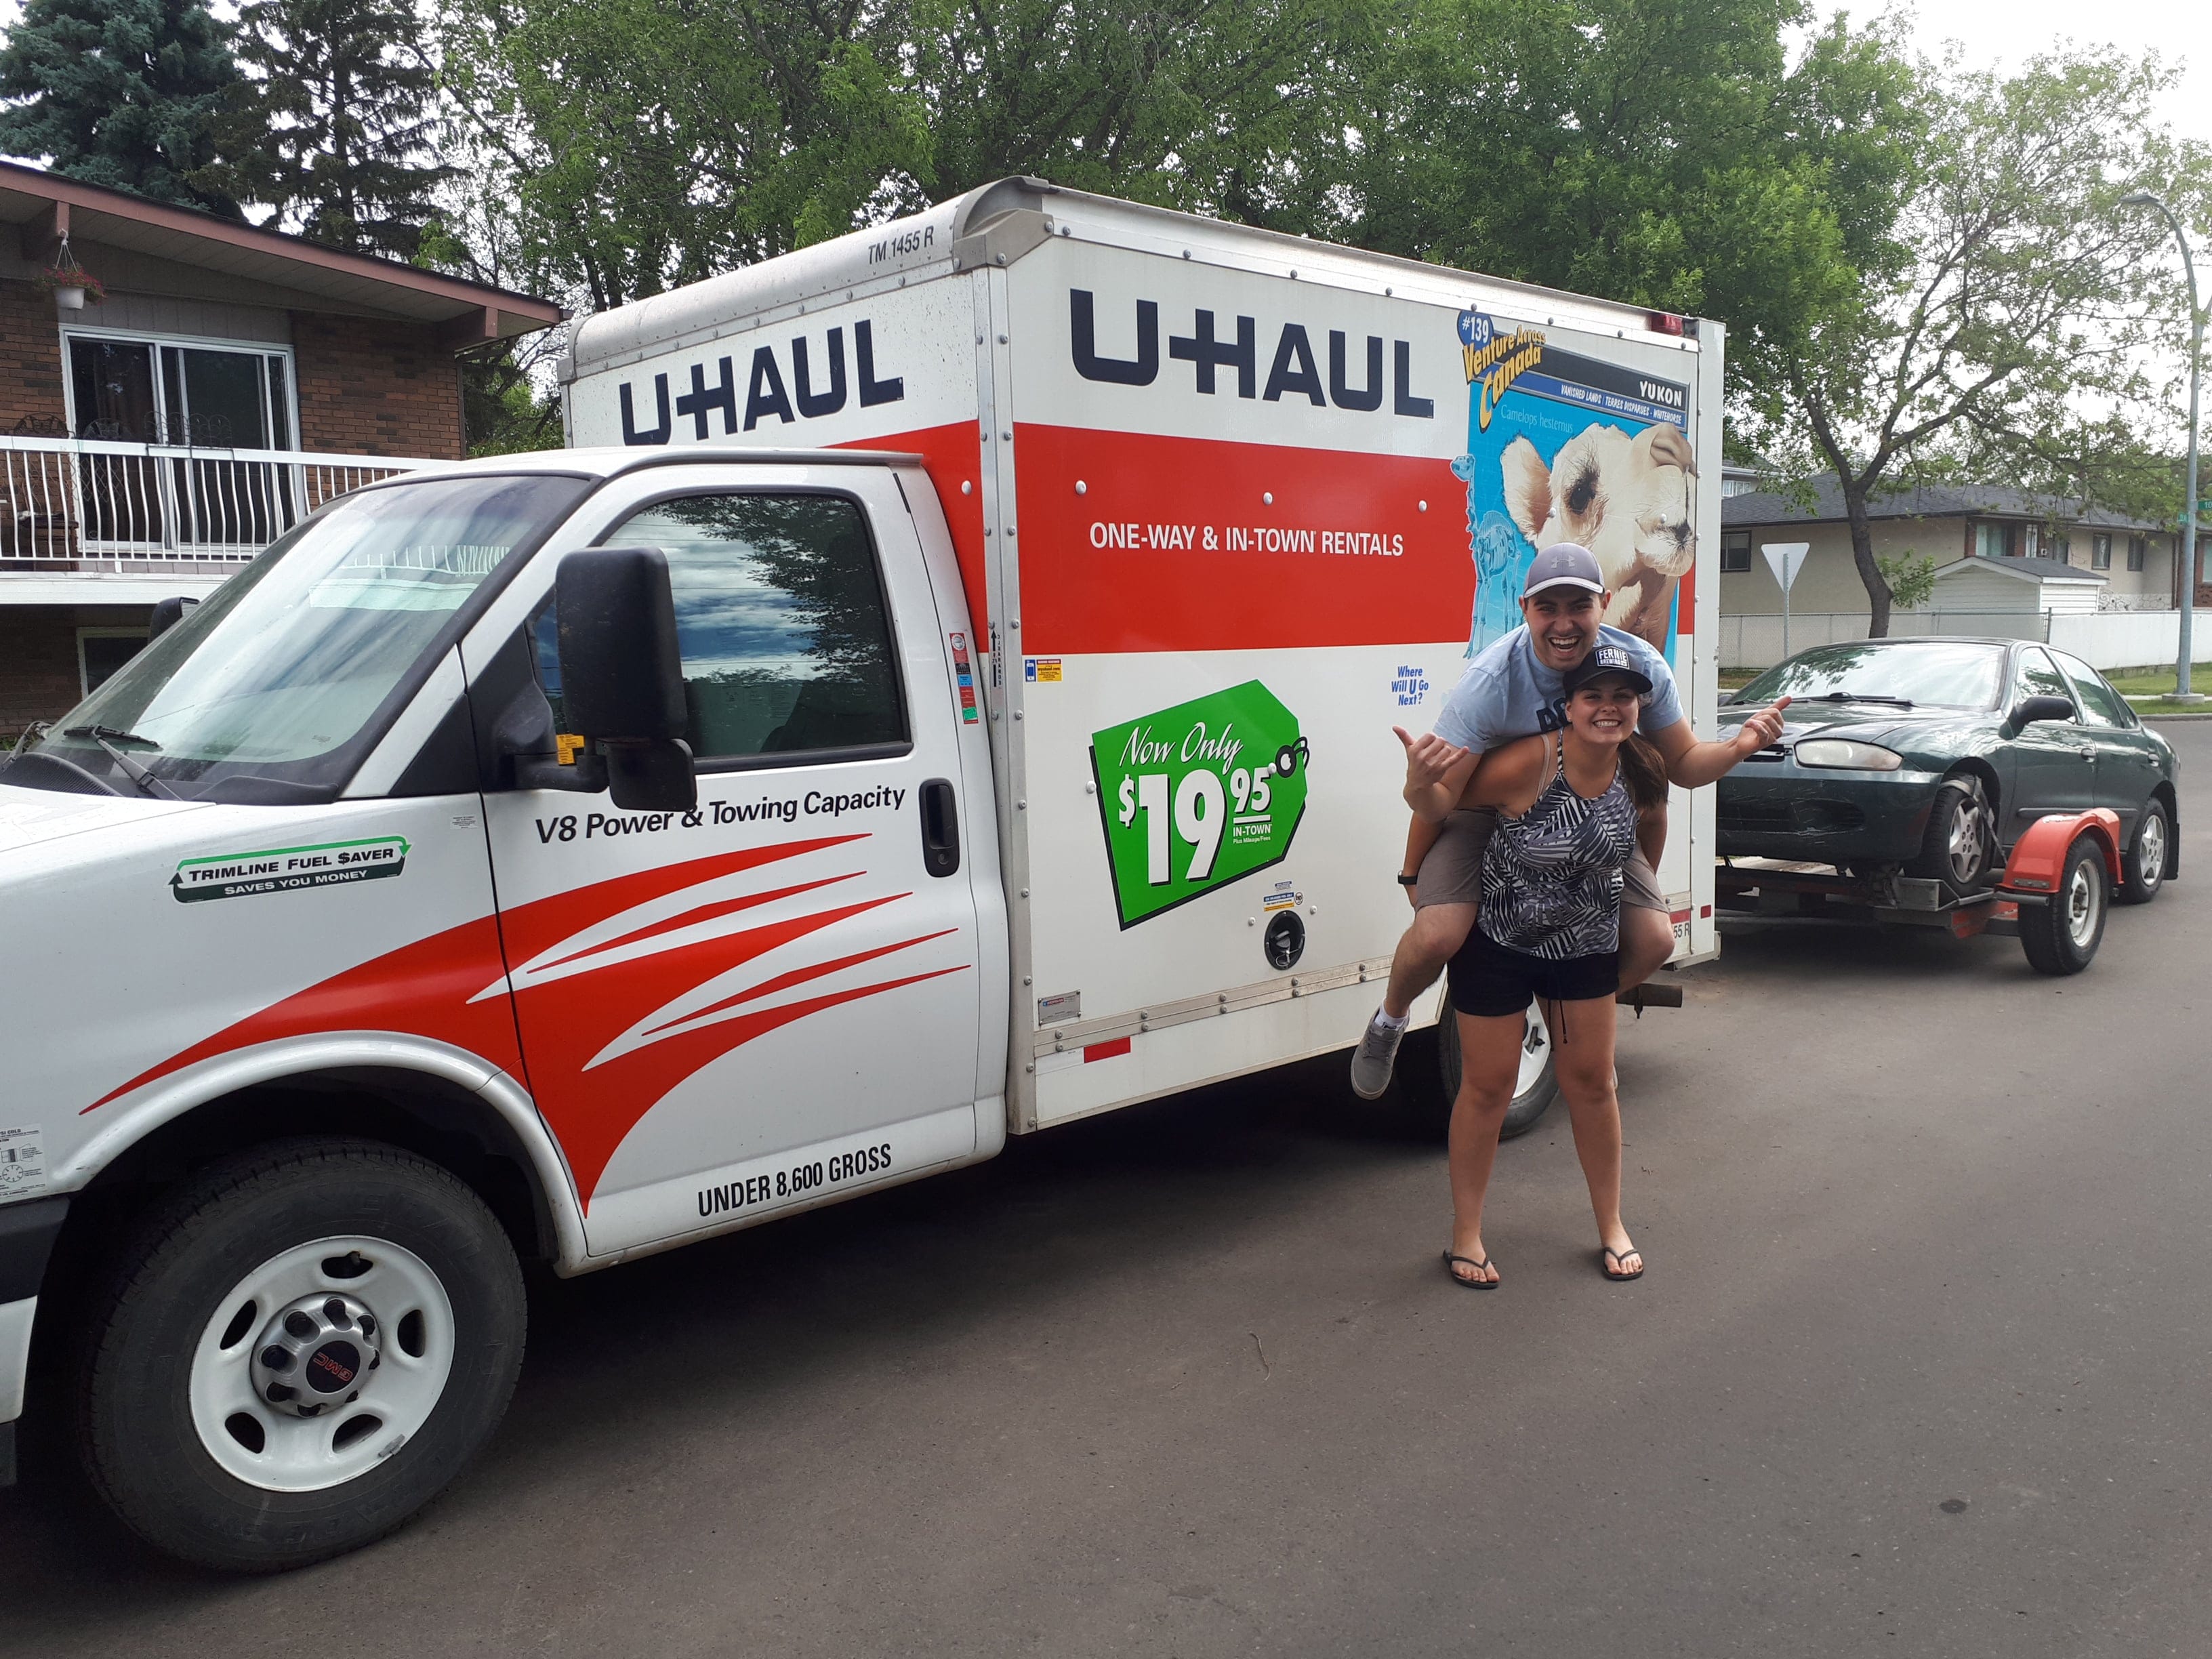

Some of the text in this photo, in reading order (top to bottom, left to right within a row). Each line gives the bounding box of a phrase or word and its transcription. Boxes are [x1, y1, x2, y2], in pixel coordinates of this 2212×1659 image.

[869, 225, 934, 264] TM 1455 R
[1462, 315, 1489, 344] #139
[1070, 288, 1434, 418] U-HAUL
[1462, 325, 1546, 383] Venture Across
[619, 319, 904, 446] U-HAUL
[1479, 343, 1542, 429] Canada
[1639, 381, 1682, 407] YUKON
[1501, 405, 1538, 430] Camelops
[1561, 384, 1585, 400] VANISHED
[1586, 391, 1601, 404] LANDS
[1605, 396, 1623, 409] TERRES
[1653, 409, 1681, 424] WHITEHORSE
[1090, 523, 1404, 556] ONE-WAY & IN-TOWN RENTALS
[1598, 648, 1626, 661] FERNIE
[1397, 665, 1422, 678] Where
[1391, 679, 1429, 695] Will U Go
[1398, 692, 1422, 705] Next?
[1119, 721, 1244, 775] Now Only
[535, 785, 906, 844] V8 Power & Towing Capacity
[1233, 824, 1272, 837] IN-TOWN
[189, 861, 279, 882] TRIMLINE
[287, 856, 332, 871] FUEL
[224, 869, 368, 895] SAVES YOU MONEY
[1684, 922, 1689, 937] R
[698, 1143, 891, 1217] UNDER 8,600 GROSS
[313, 1351, 353, 1382] GMC
